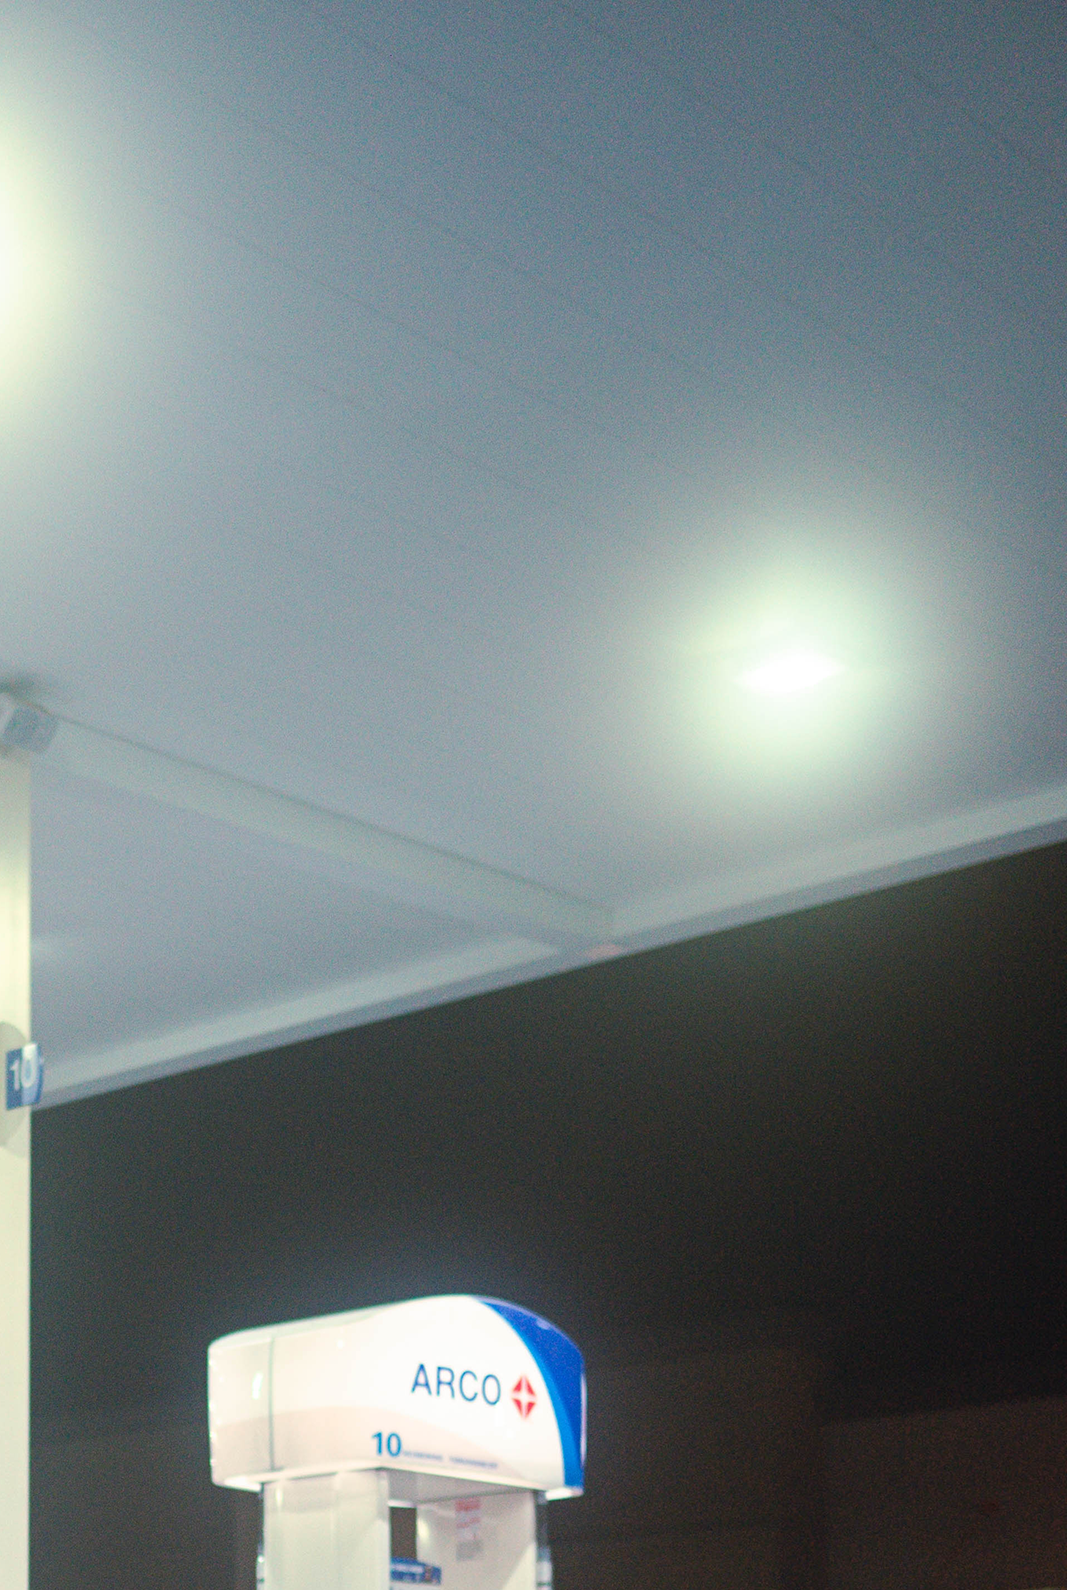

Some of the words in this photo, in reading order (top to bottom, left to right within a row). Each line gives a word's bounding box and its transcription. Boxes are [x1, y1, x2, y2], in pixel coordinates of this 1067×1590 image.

[10, 1057, 37, 1091] 10
[411, 1363, 501, 1406] ARCO
[372, 1432, 402, 1457] 10
